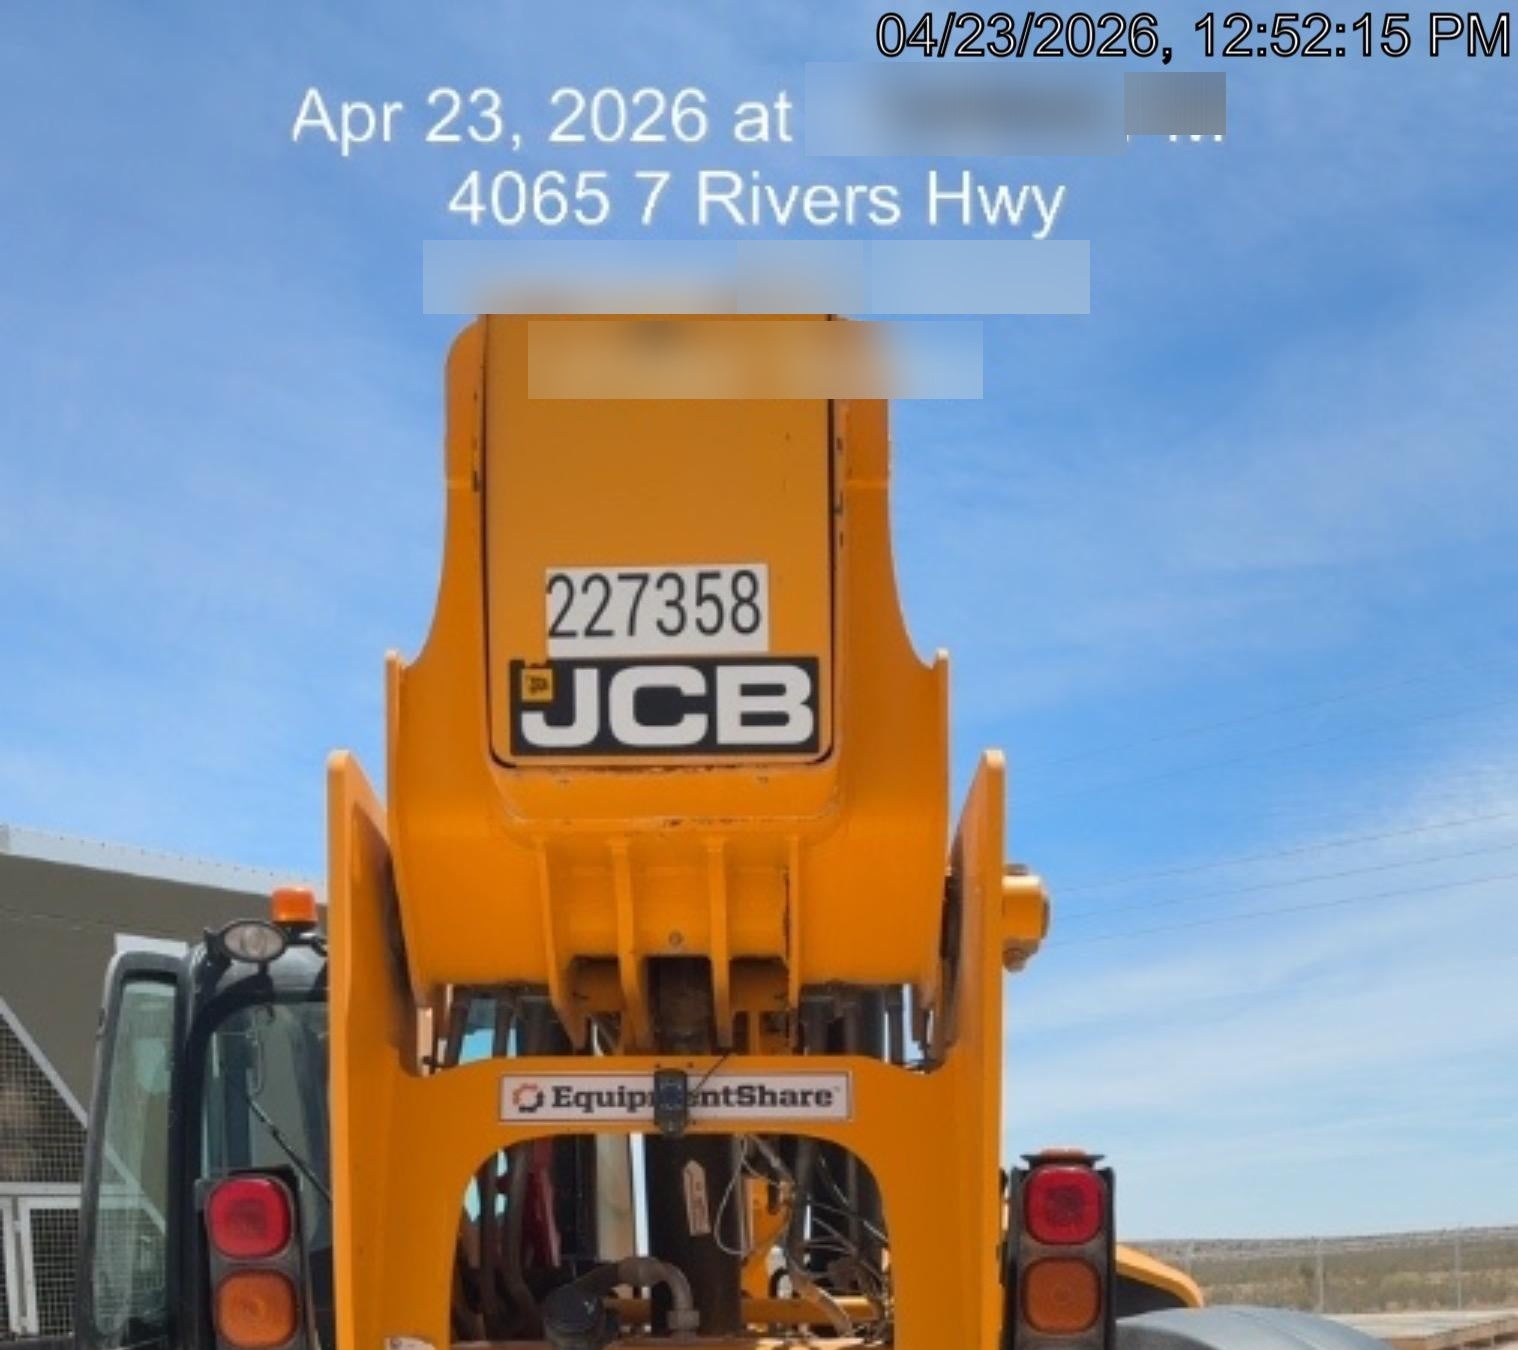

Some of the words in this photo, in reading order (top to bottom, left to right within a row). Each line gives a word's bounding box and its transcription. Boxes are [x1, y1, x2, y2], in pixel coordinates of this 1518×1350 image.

[546, 569, 761, 638] 227358
[521, 665, 814, 747] JCB
[551, 1085, 834, 1113] EquipentShare
